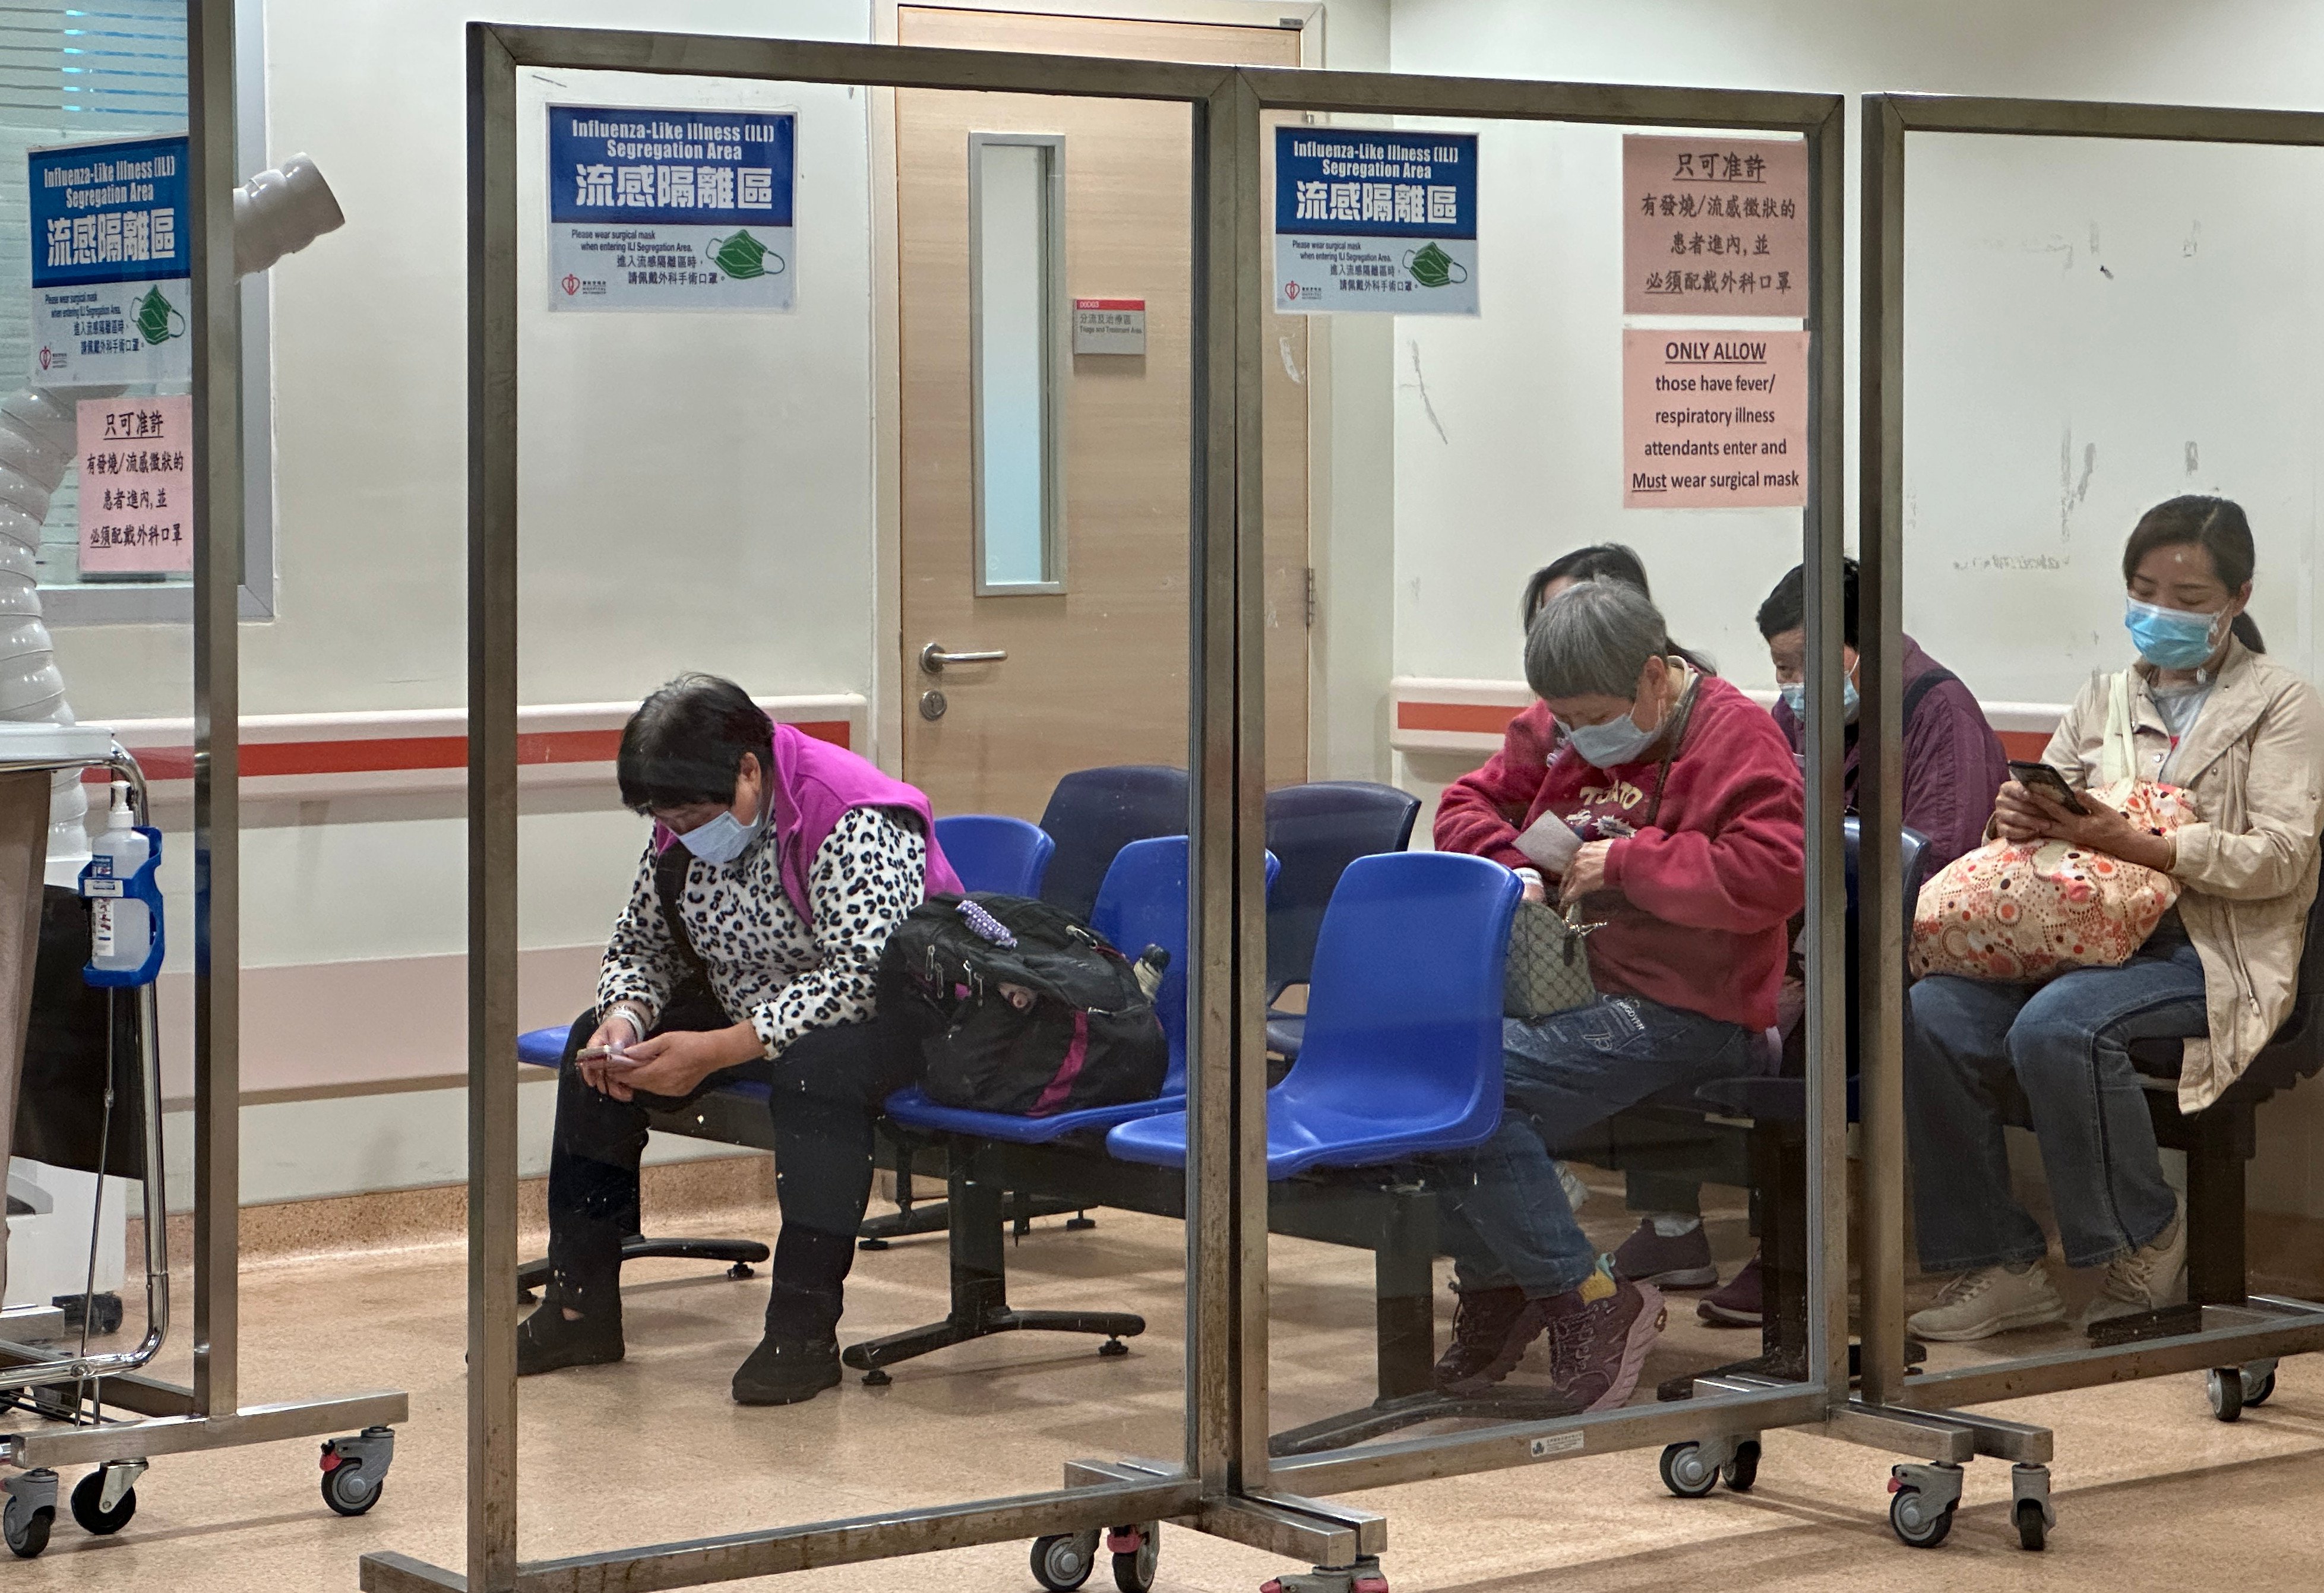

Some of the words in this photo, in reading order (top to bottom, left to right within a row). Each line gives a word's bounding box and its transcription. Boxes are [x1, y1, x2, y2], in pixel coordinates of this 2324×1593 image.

[573, 119, 682, 140] Influenza-Like
[688, 123, 740, 141] Illness
[745, 125, 774, 143] (ILI)
[608, 140, 703, 160] Segregation
[707, 143, 742, 160] Area
[1294, 141, 1383, 160] Influenza-Like
[1387, 144, 1430, 161] Illness
[1434, 147, 1459, 163] (ILI)
[44, 160, 113, 188] Influenza-Like
[116, 159, 153, 180] Illness
[154, 156, 175, 178] (ILI)
[1322, 160, 1400, 178] Segregation
[1403, 163, 1432, 179] Area
[1674, 150, 1766, 181] 只可准許
[66, 186, 126, 210] Segregation
[130, 182, 154, 202] Area
[576, 163, 772, 208] 流感隔離區
[1296, 181, 1457, 224] 流感隔離區
[1642, 192, 1795, 219] 有發燒/流感徵狀的
[48, 208, 175, 267] 流感隔離區
[572, 229, 593, 239] Please
[612, 230, 637, 241] surgical
[638, 230, 656, 239] mask
[581, 241, 598, 251] when
[600, 242, 625, 254] entering
[627, 242, 635, 251] ILI
[637, 242, 675, 254] Segregation
[1645, 270, 1791, 295] 必須配戴外科口罩
[1665, 342, 1710, 360] ONLY
[1713, 342, 1766, 360] ALLOW
[1656, 375, 1696, 391] those
[1700, 375, 1732, 391] have
[1735, 374, 1776, 393] fever/
[103, 409, 163, 437] 只可准許
[1655, 408, 1731, 426] respiratory
[1735, 407, 1775, 423] illness
[1645, 440, 1719, 456] attendants
[1723, 442, 1757, 455] enter
[1761, 438, 1787, 454] and
[1633, 473, 1667, 488] Must
[1671, 475, 1706, 488] wear
[1710, 471, 1759, 491] surgical
[1764, 470, 1799, 487] mask
[90, 523, 183, 547] 必須配戴外科口罩
